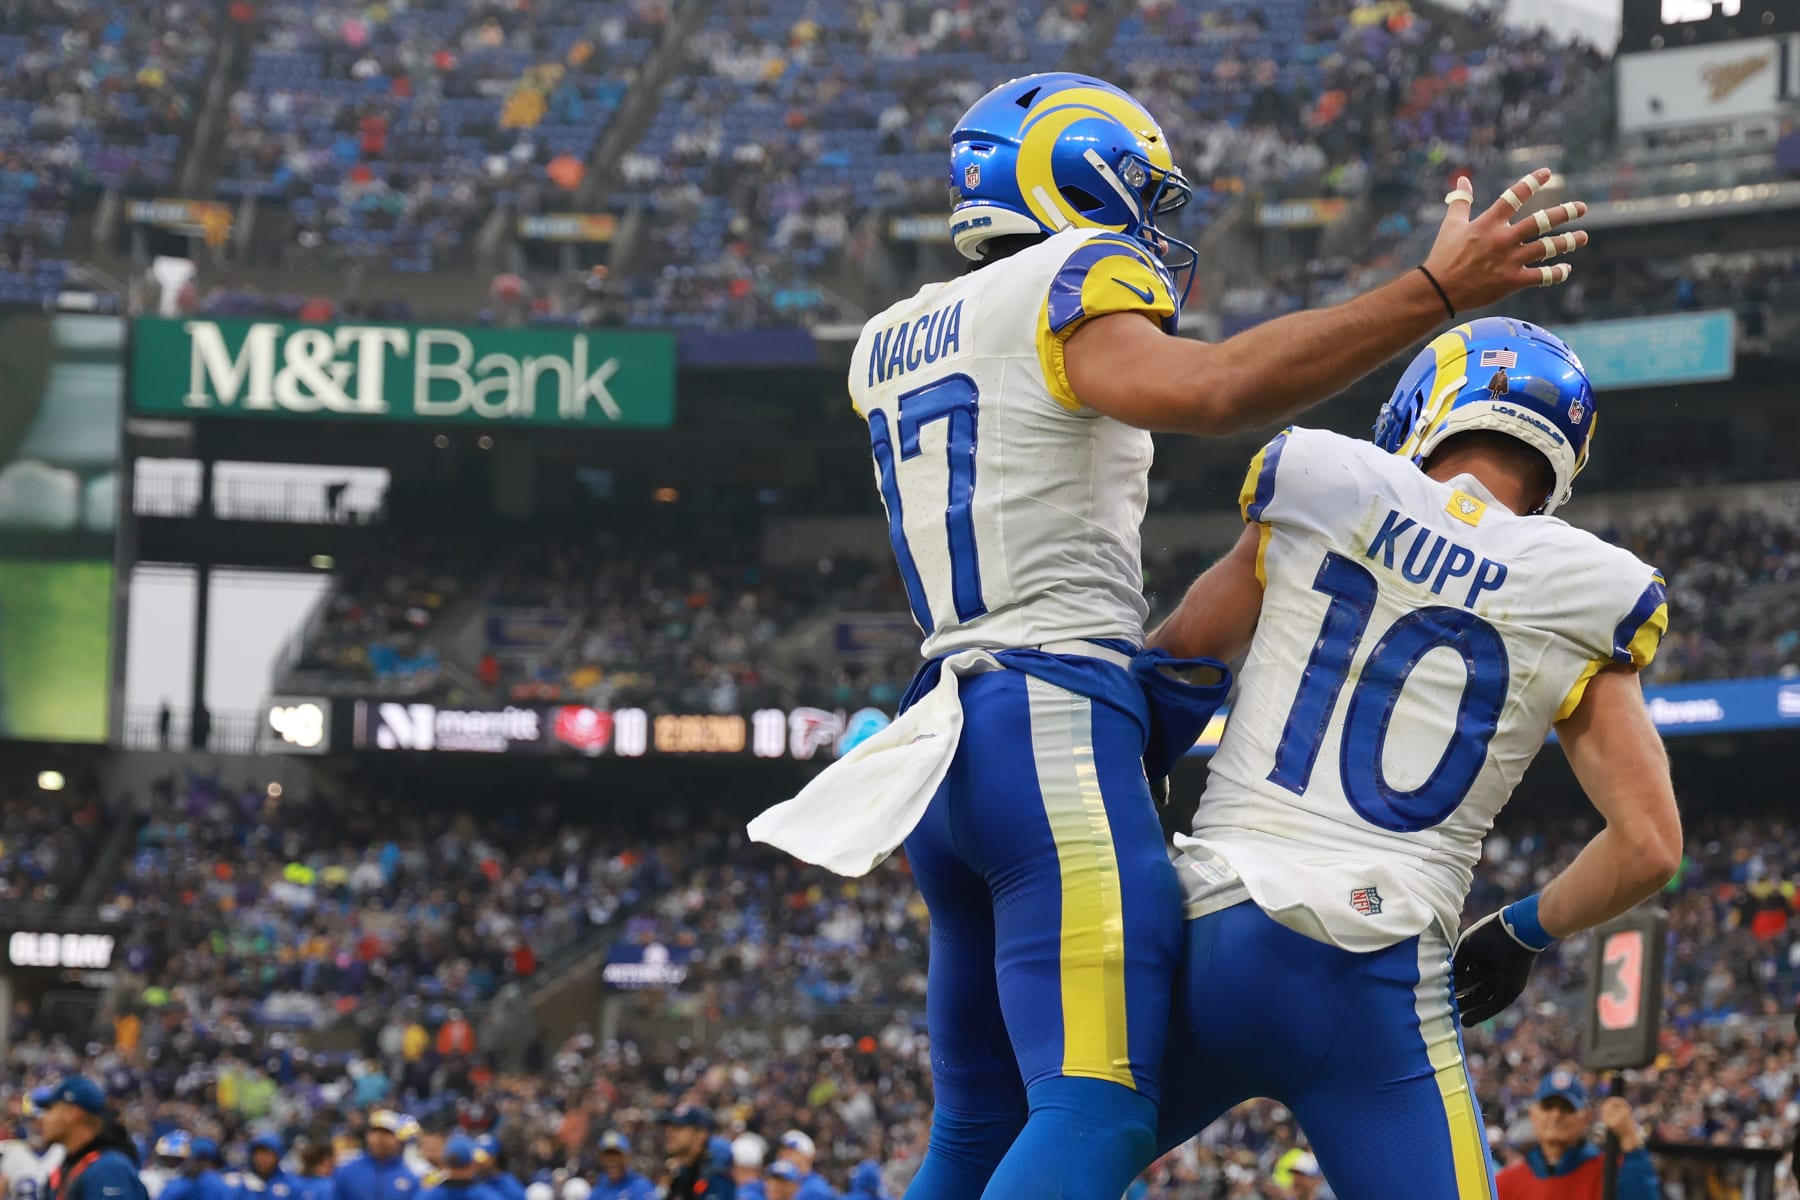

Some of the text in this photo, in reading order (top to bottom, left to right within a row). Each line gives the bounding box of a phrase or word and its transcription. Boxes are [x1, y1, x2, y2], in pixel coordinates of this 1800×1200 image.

[183, 320, 622, 421] M&T Bank
[867, 299, 965, 388] NACUA
[1491, 404, 1566, 446] LOS ANGELES
[867, 372, 989, 639] 17
[1365, 509, 1509, 609] KUPP
[1266, 550, 1510, 833] 10
[1596, 930, 1643, 1030] 3
